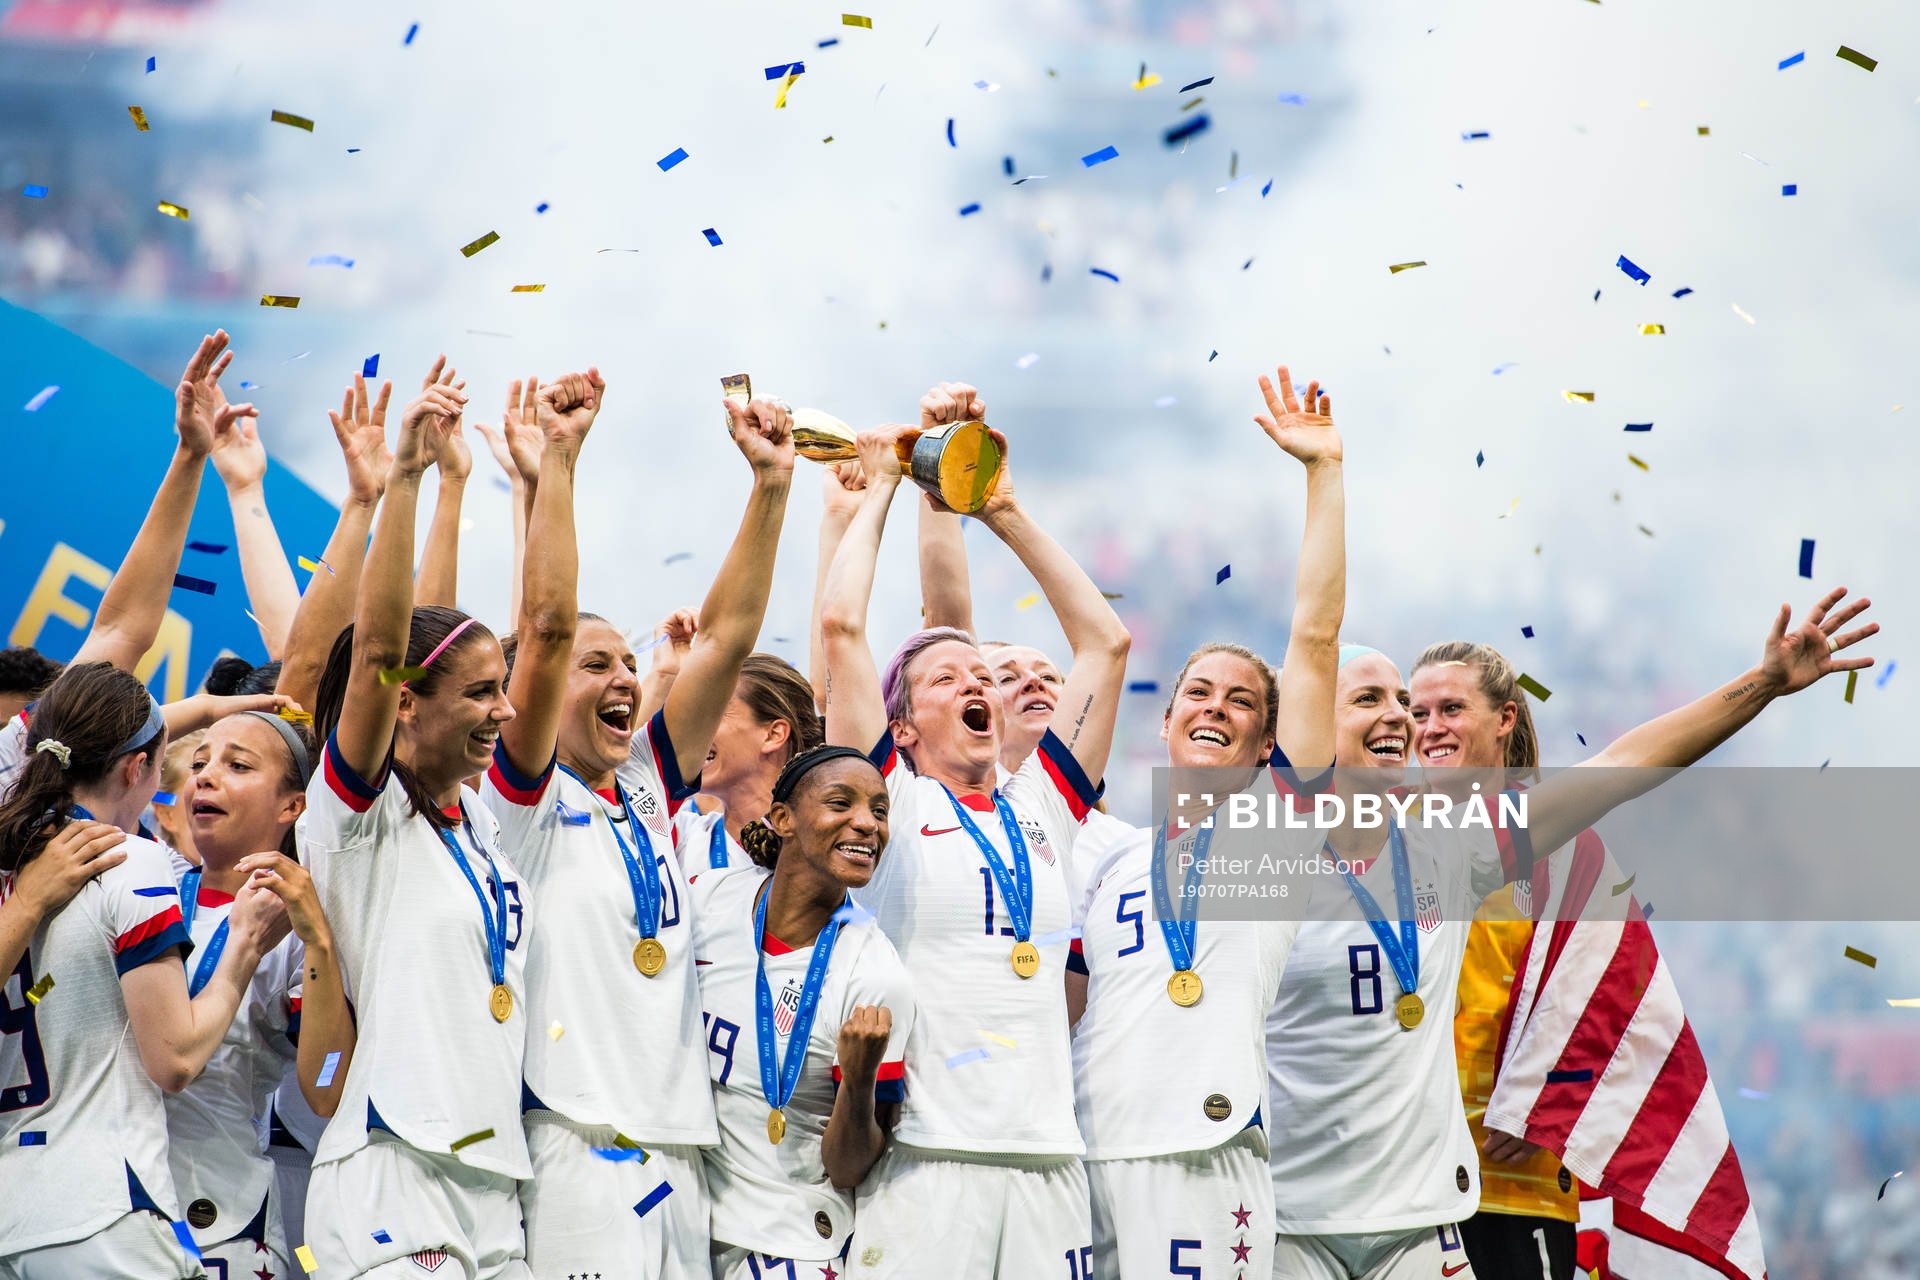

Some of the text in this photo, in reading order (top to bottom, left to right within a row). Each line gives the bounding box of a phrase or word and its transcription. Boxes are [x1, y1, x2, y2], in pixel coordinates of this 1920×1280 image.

[637, 796, 657, 815] USA
[1024, 829, 1045, 845] USA
[999, 870, 1008, 884] FIFA
[1008, 892, 1017, 907] FIFA
[1516, 880, 1531, 895] US
[1416, 894, 1436, 911] SA
[1116, 890, 1146, 958] 5
[1171, 937, 1180, 952] FIFA
[1017, 955, 1035, 964] FIFA
[1348, 944, 1383, 1015] 8
[782, 992, 800, 1012] US
[702, 1012, 740, 1087] 9
[1170, 1239, 1201, 1280] 5
[1532, 1228, 1553, 1280] 1
